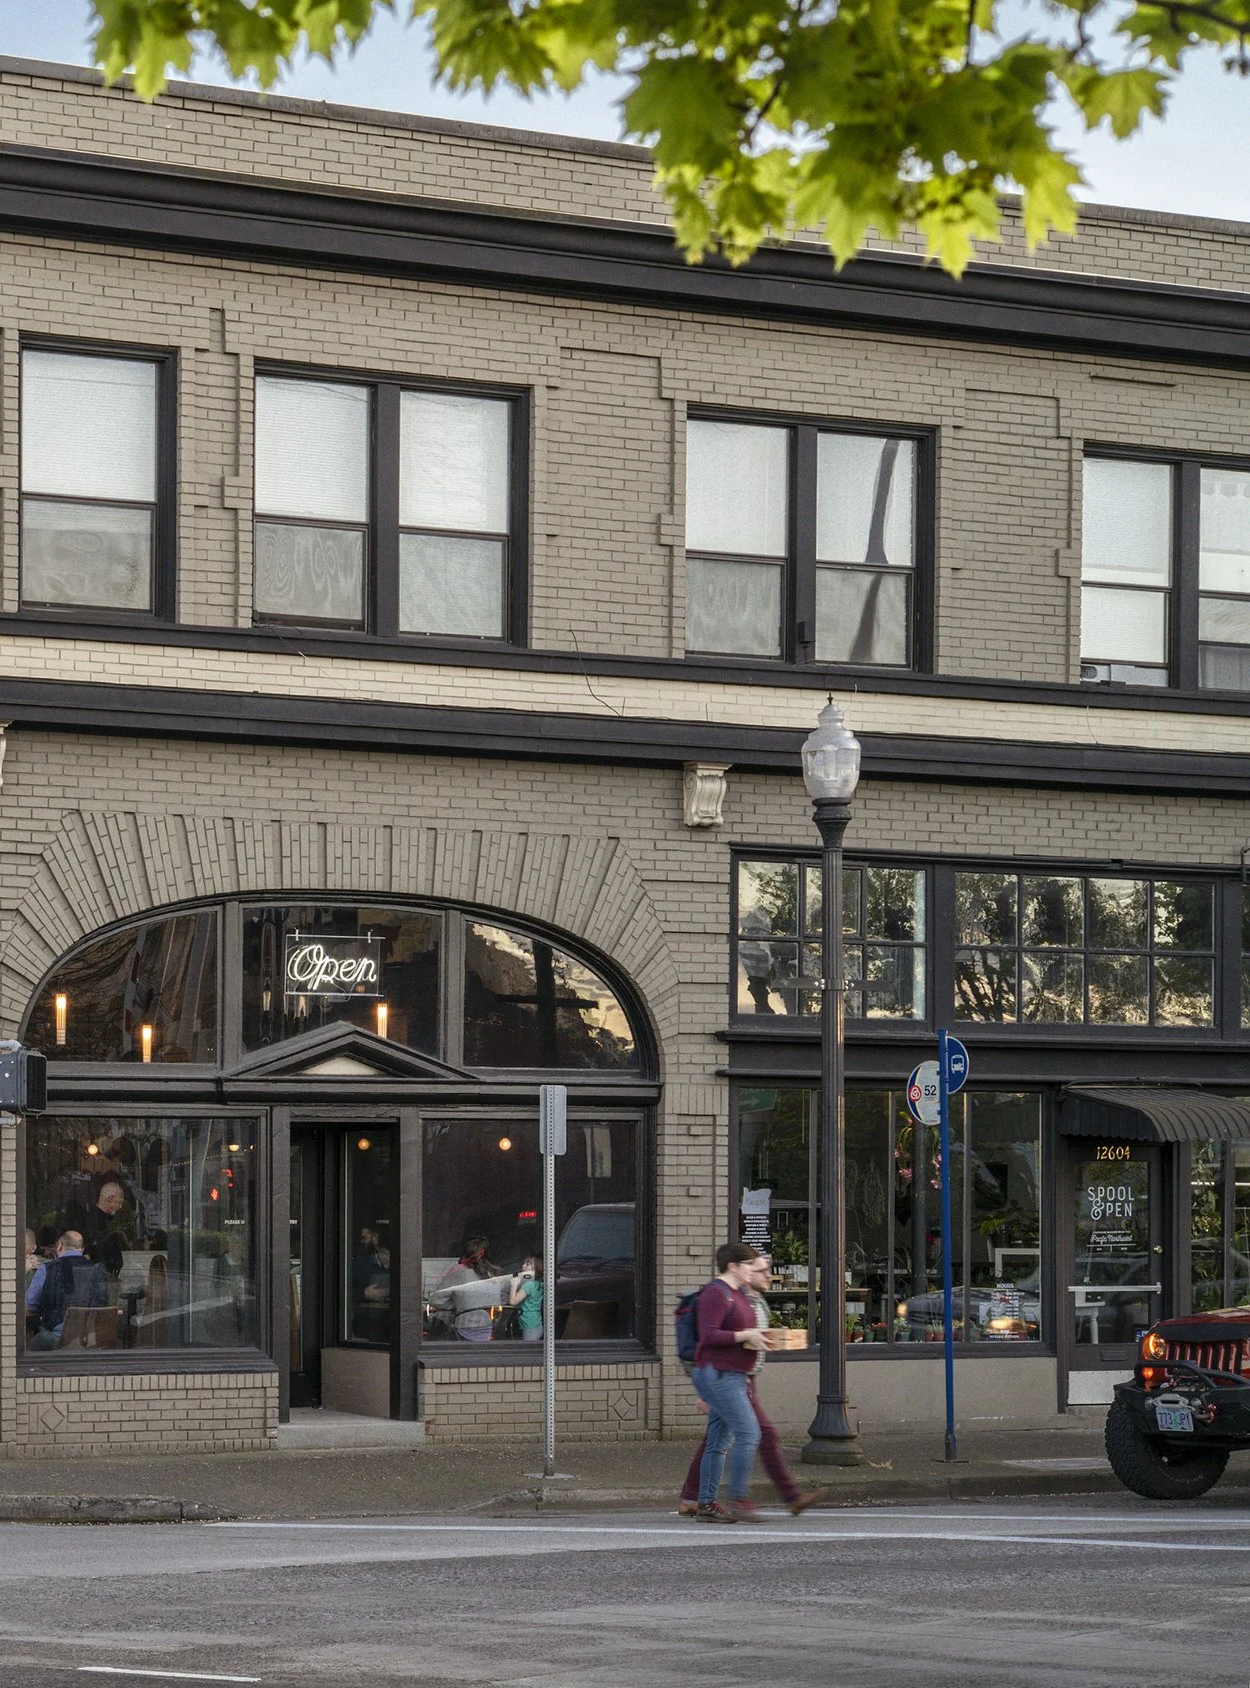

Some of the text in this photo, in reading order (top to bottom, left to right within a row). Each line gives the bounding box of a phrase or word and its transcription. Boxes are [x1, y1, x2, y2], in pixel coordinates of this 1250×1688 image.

[287, 944, 377, 990] Open
[924, 1084, 938, 1097] 52
[1096, 1146, 1131, 1160] 12604
[1087, 1186, 1135, 1201] SPOOL
[1091, 1199, 1132, 1220] & PEN
[1158, 1412, 1174, 1425] 773
